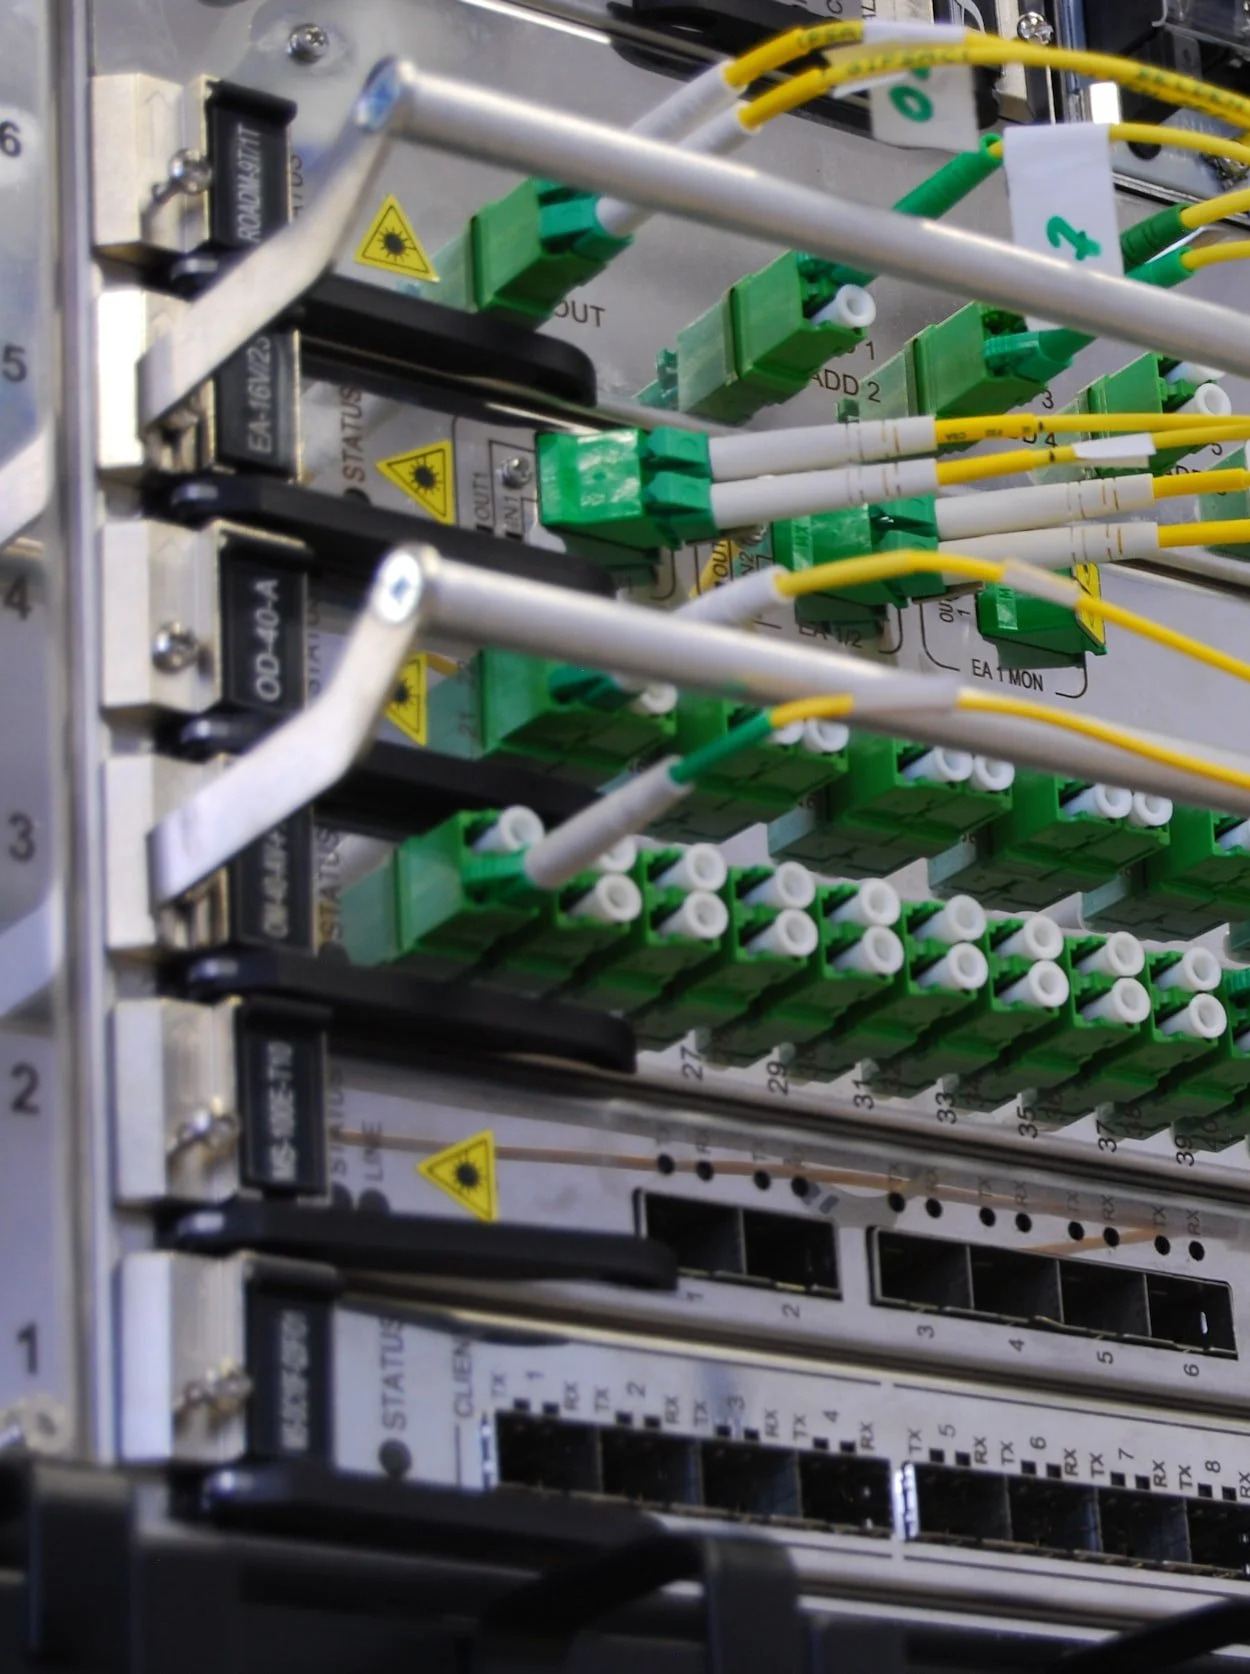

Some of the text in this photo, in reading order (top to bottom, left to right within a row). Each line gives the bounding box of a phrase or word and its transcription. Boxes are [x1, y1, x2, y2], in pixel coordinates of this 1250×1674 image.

[3, 344, 27, 382] 5
[867, 381, 882, 403] 2
[340, 386, 367, 484] STATUS
[6, 575, 32, 621] 4
[255, 578, 281, 702] OD-40-A
[971, 658, 993, 681] EA
[1009, 669, 1044, 693] MON
[9, 812, 36, 862] 3
[680, 1045, 703, 1081] 27
[10, 1061, 41, 1116] 2
[766, 1061, 790, 1096] 29
[853, 1078, 876, 1111] 31
[935, 1091, 958, 1125] 33
[1016, 1105, 1039, 1139] 35
[1096, 1119, 1118, 1153] 37
[1174, 1134, 1196, 1167] 39
[1014, 1180, 1028, 1207] RX
[1102, 1194, 1117, 1221] RX
[1153, 1205, 1168, 1231] TX
[1187, 1208, 1201, 1236] RX
[686, 1290, 704, 1301] 1
[781, 1303, 800, 1319] 2
[916, 1323, 935, 1339] 3
[1009, 1338, 1025, 1352] 4
[17, 1320, 39, 1376] 1
[1096, 1350, 1114, 1365] 5
[380, 1317, 408, 1433] STATUS
[452, 1338, 474, 1419] CLIEN
[1183, 1362, 1200, 1378] 6
[564, 1381, 581, 1411] RX
[594, 1386, 610, 1413] TX
[626, 1380, 646, 1397] 2
[727, 1394, 746, 1411] 3
[664, 1393, 680, 1425] RX
[693, 1399, 708, 1426] TX
[764, 1407, 780, 1438] RX
[823, 1409, 839, 1424] 4
[792, 1414, 808, 1439] TX
[859, 1421, 876, 1450] RX
[908, 1427, 923, 1453] TX
[938, 1423, 956, 1438] 5
[974, 1436, 988, 1465] RX
[1000, 1440, 1015, 1466] TX
[1030, 1436, 1047, 1450] 6
[1118, 1448, 1135, 1461] 7
[1063, 1448, 1079, 1477] RX
[1089, 1452, 1105, 1479] TX
[1152, 1459, 1168, 1488] RX
[1204, 1460, 1221, 1474] 8
[1178, 1464, 1194, 1490] TX
